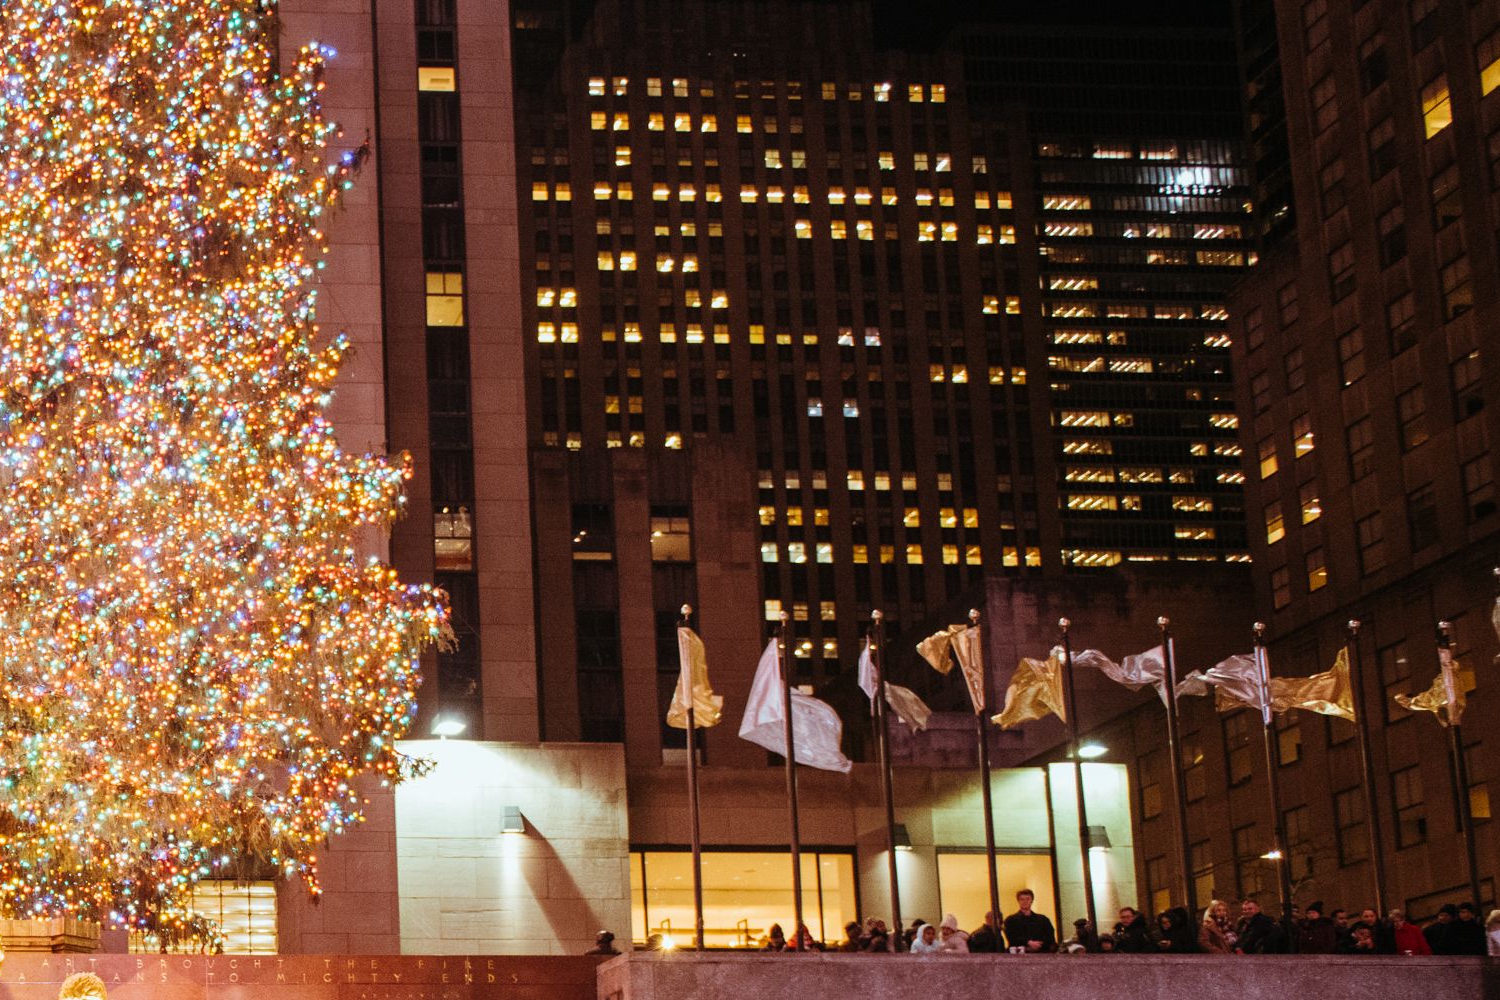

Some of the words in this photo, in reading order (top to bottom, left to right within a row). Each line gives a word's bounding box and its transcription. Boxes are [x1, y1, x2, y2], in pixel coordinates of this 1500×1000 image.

[41, 958, 98, 969] ART
[136, 959, 285, 970] BROUGHT
[323, 959, 380, 970] THE
[416, 960, 496, 970] FIRE
[205, 973, 240, 983] TO
[275, 973, 403, 984] MIGHTY
[441, 974, 520, 985] ENDS
